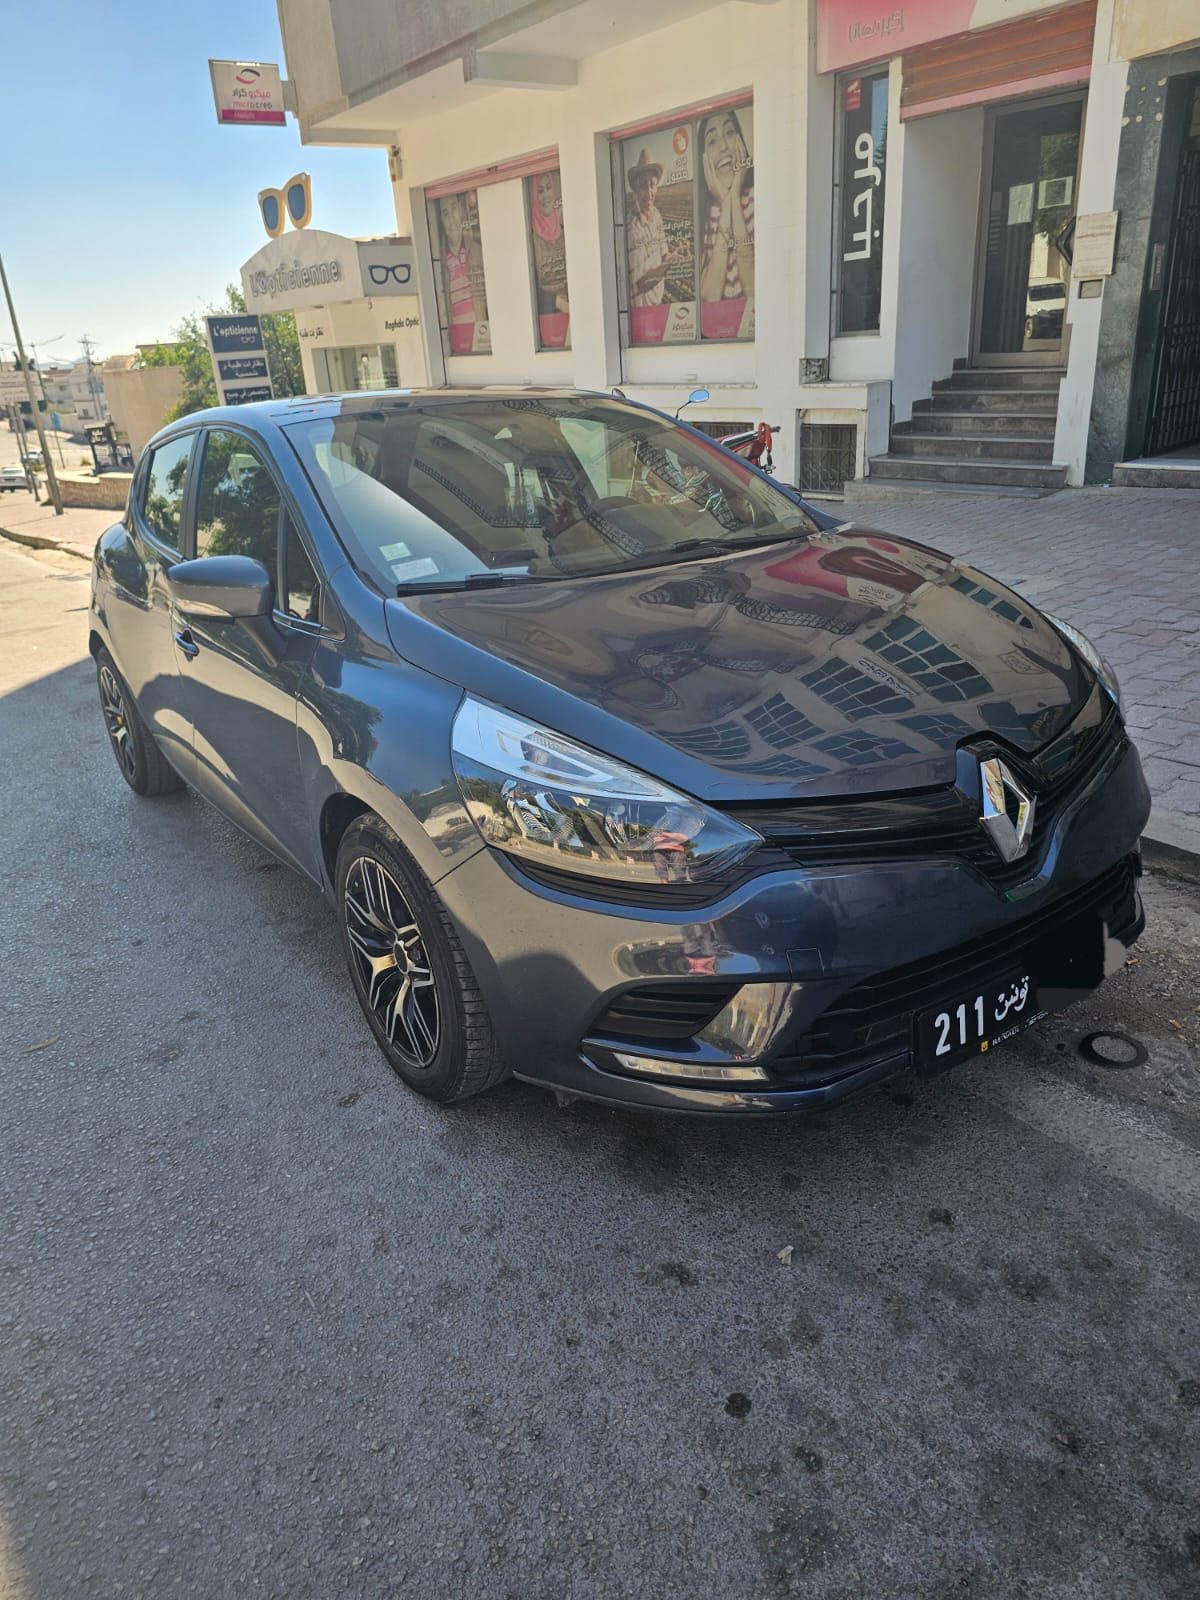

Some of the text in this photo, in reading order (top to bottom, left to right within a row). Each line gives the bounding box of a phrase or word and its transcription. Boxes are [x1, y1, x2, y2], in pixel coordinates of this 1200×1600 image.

[844, 132, 882, 262] مرحبا
[934, 975, 1030, 1057] 211 تونس
